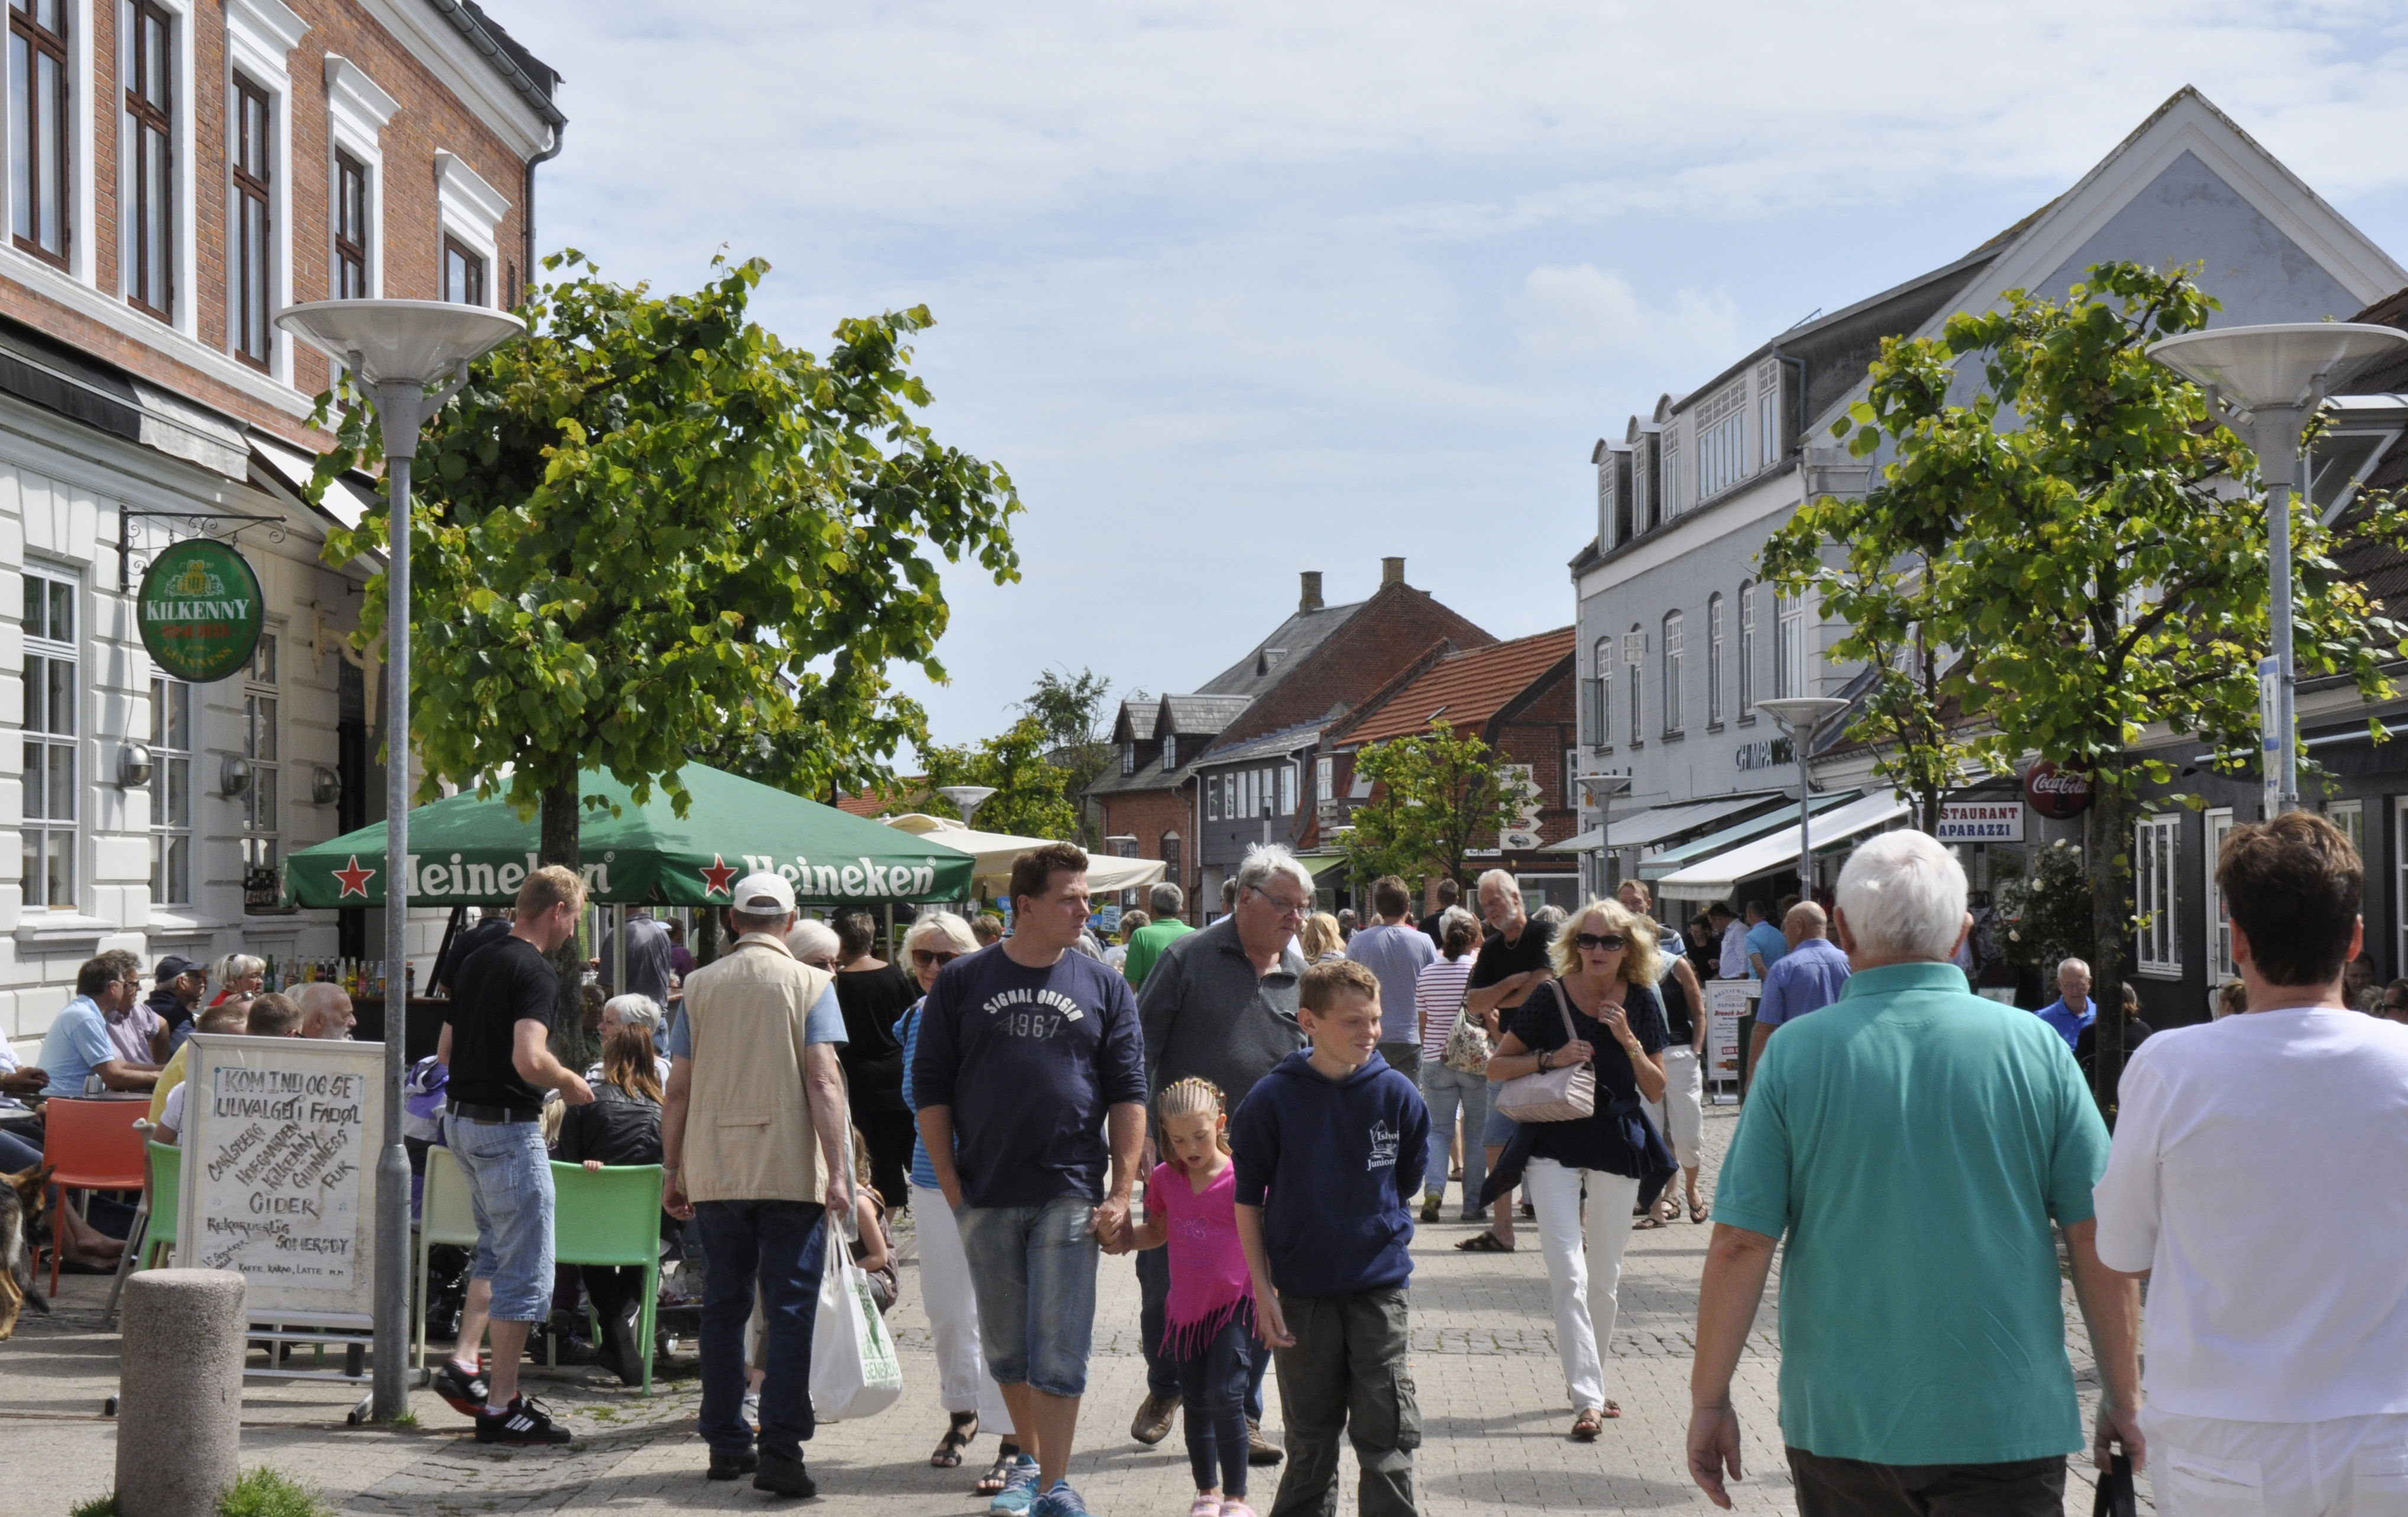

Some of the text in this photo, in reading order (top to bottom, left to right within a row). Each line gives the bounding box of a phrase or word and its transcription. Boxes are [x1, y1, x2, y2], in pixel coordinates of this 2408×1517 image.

[146, 599, 250, 621] KILKENNY
[1922, 807, 2018, 820] STAURANT
[1938, 824, 2011, 837] APARAZZI
[384, 852, 611, 896] einen
[983, 988, 1033, 1014] SIGNAL
[1009, 1012, 1061, 1038] 1967
[225, 1071, 354, 1098] KOM IND OG SE
[310, 1102, 361, 1126] FADØL
[321, 1160, 359, 1190] FUR
[297, 1264, 322, 1275] LATTE
